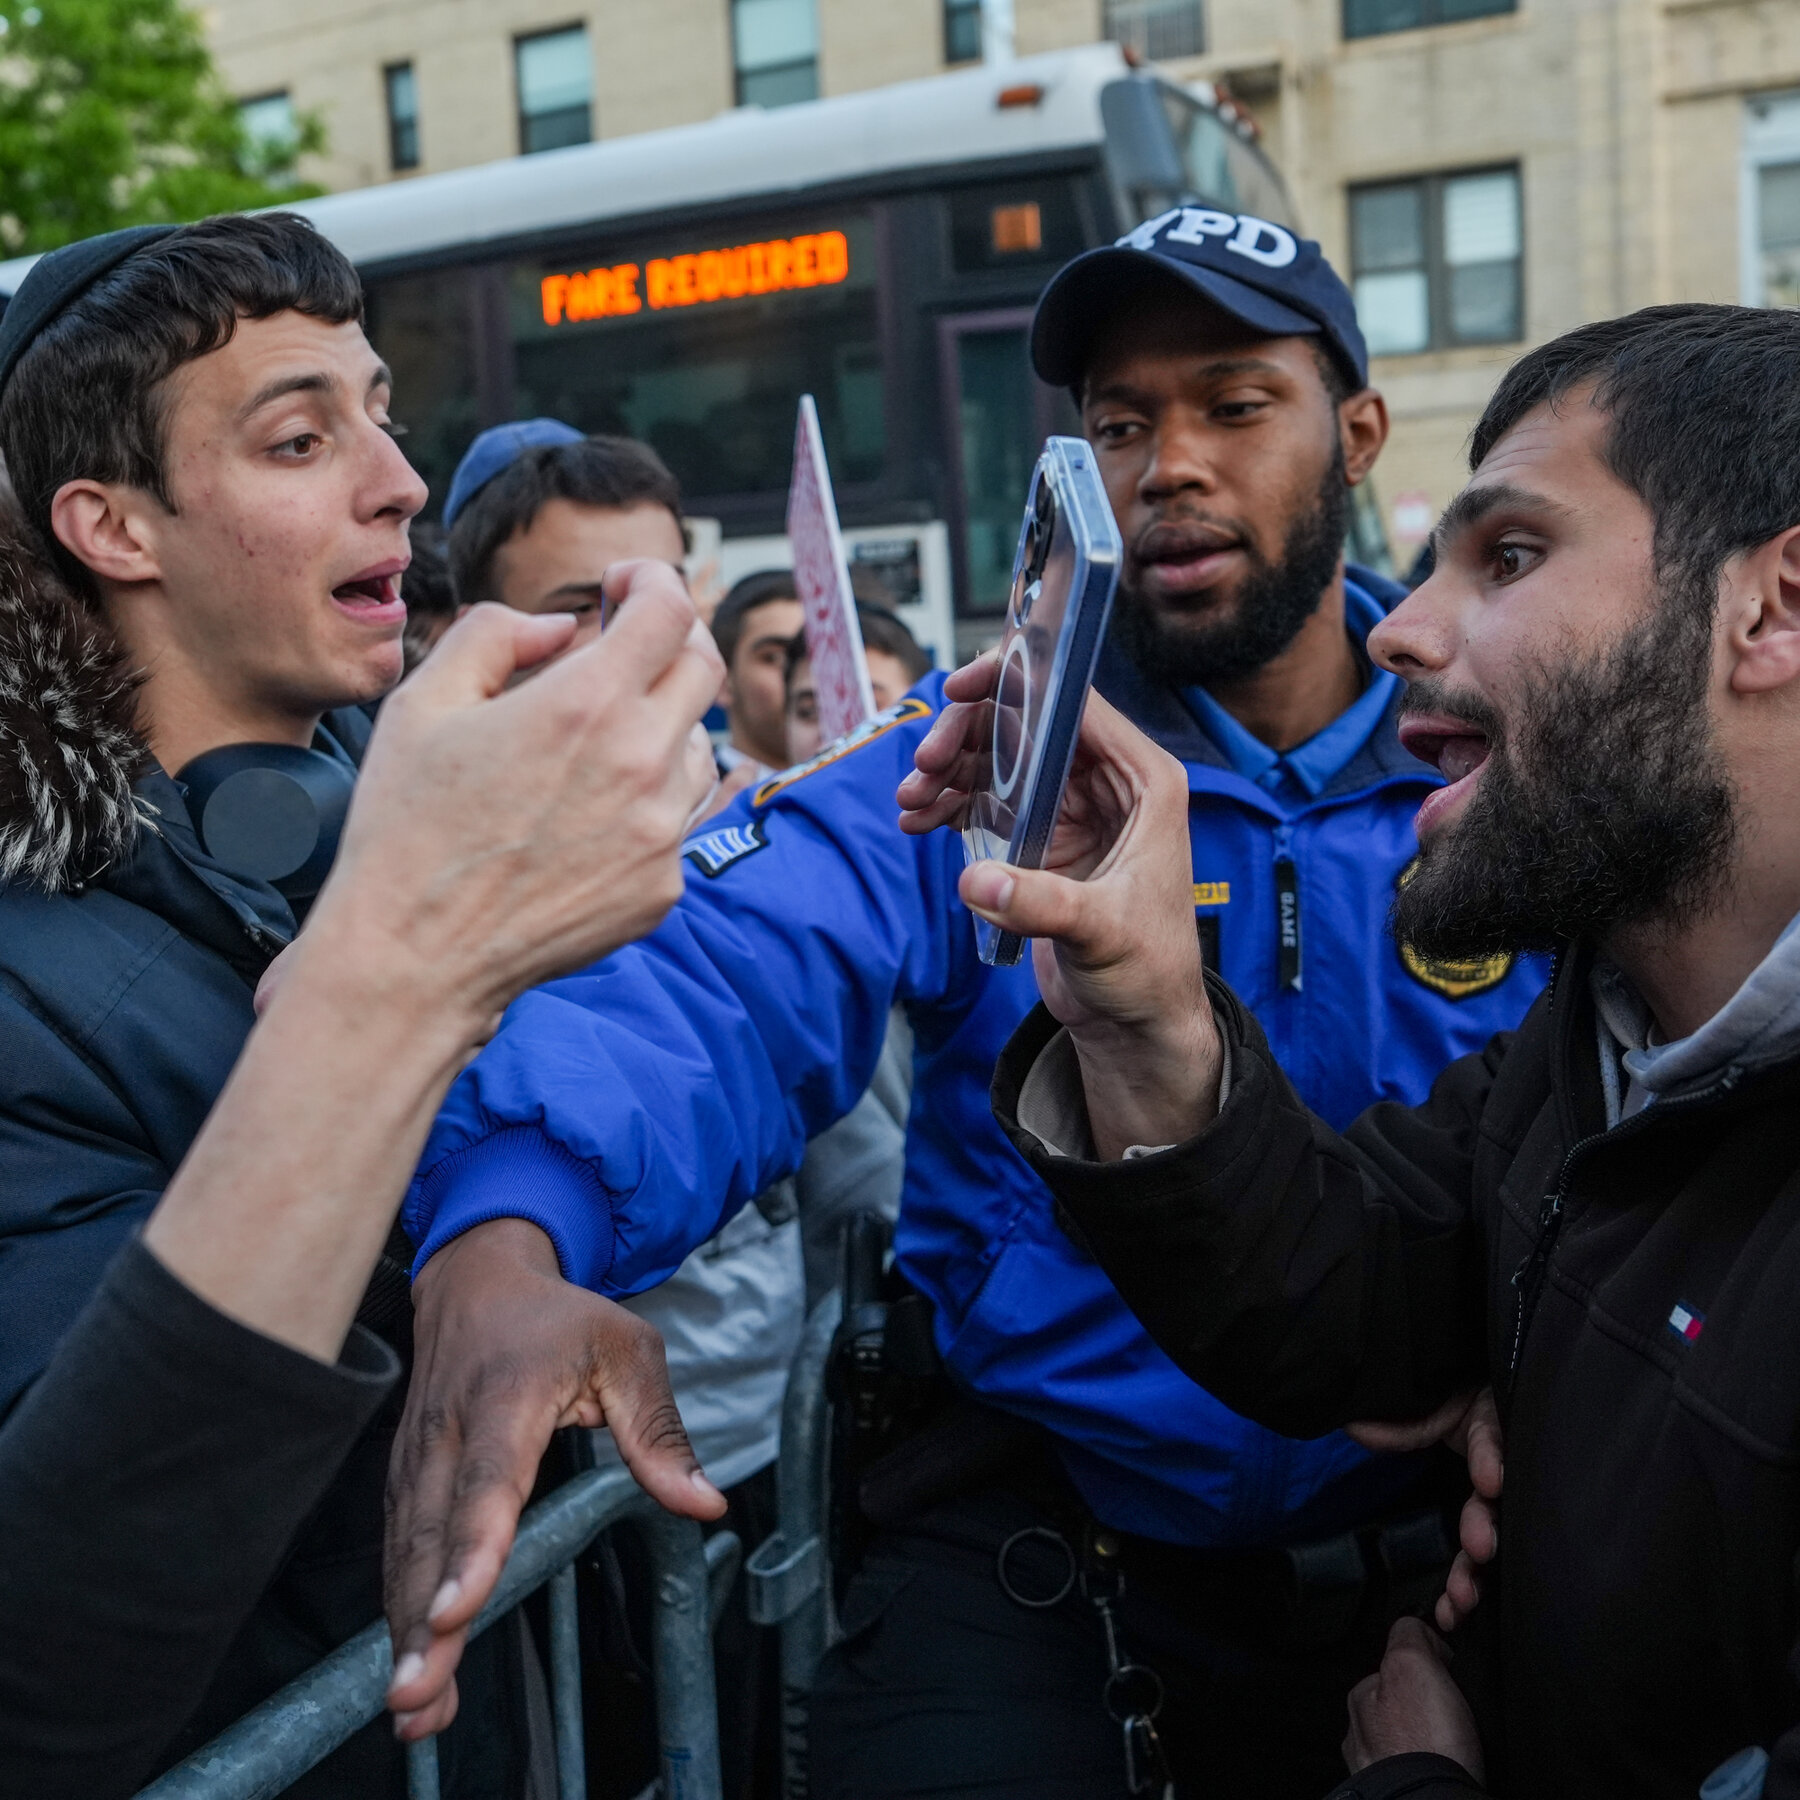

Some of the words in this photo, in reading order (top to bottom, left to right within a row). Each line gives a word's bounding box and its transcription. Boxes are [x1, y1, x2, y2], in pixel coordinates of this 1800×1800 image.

[1114, 207, 1297, 268] YPD
[541, 263, 642, 326] FARE
[645, 230, 849, 310] REQUIRED
